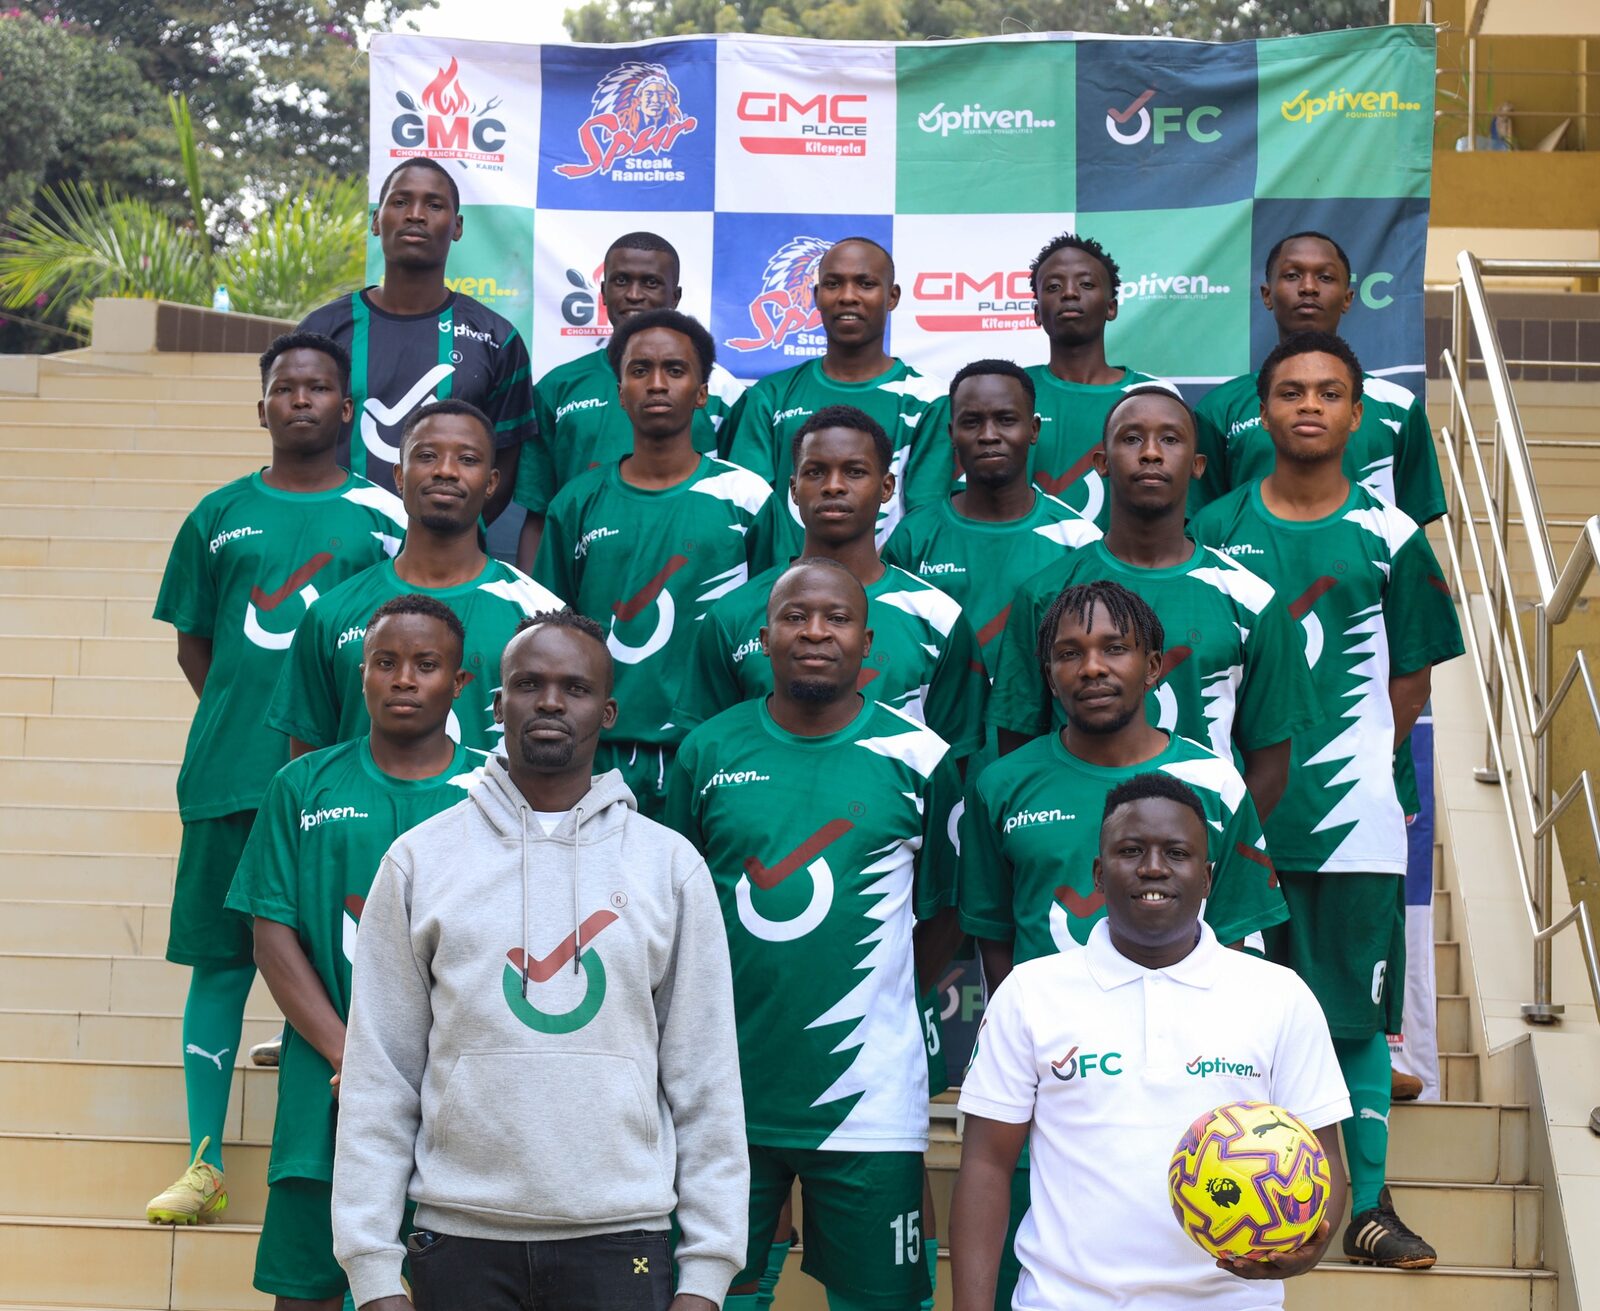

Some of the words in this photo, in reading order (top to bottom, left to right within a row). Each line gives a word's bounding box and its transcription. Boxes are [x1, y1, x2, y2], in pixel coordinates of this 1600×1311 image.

[737, 92, 867, 124] GMC
[391, 113, 506, 153] GMC
[802, 125, 867, 136] PLACE
[552, 112, 698, 179] Spur
[805, 141, 862, 156] Kitengela
[396, 150, 426, 158] CHOMA
[428, 150, 456, 159] RANCH
[464, 152, 500, 161] PIZZERIA
[475, 163, 503, 172] KAREN
[625, 157, 673, 169] Steak
[612, 170, 685, 182] Ranches
[797, 333, 828, 345] Ste
[784, 344, 828, 356] Ranc
[209, 526, 263, 554] ptiven...
[889, 1209, 920, 1266] 15
